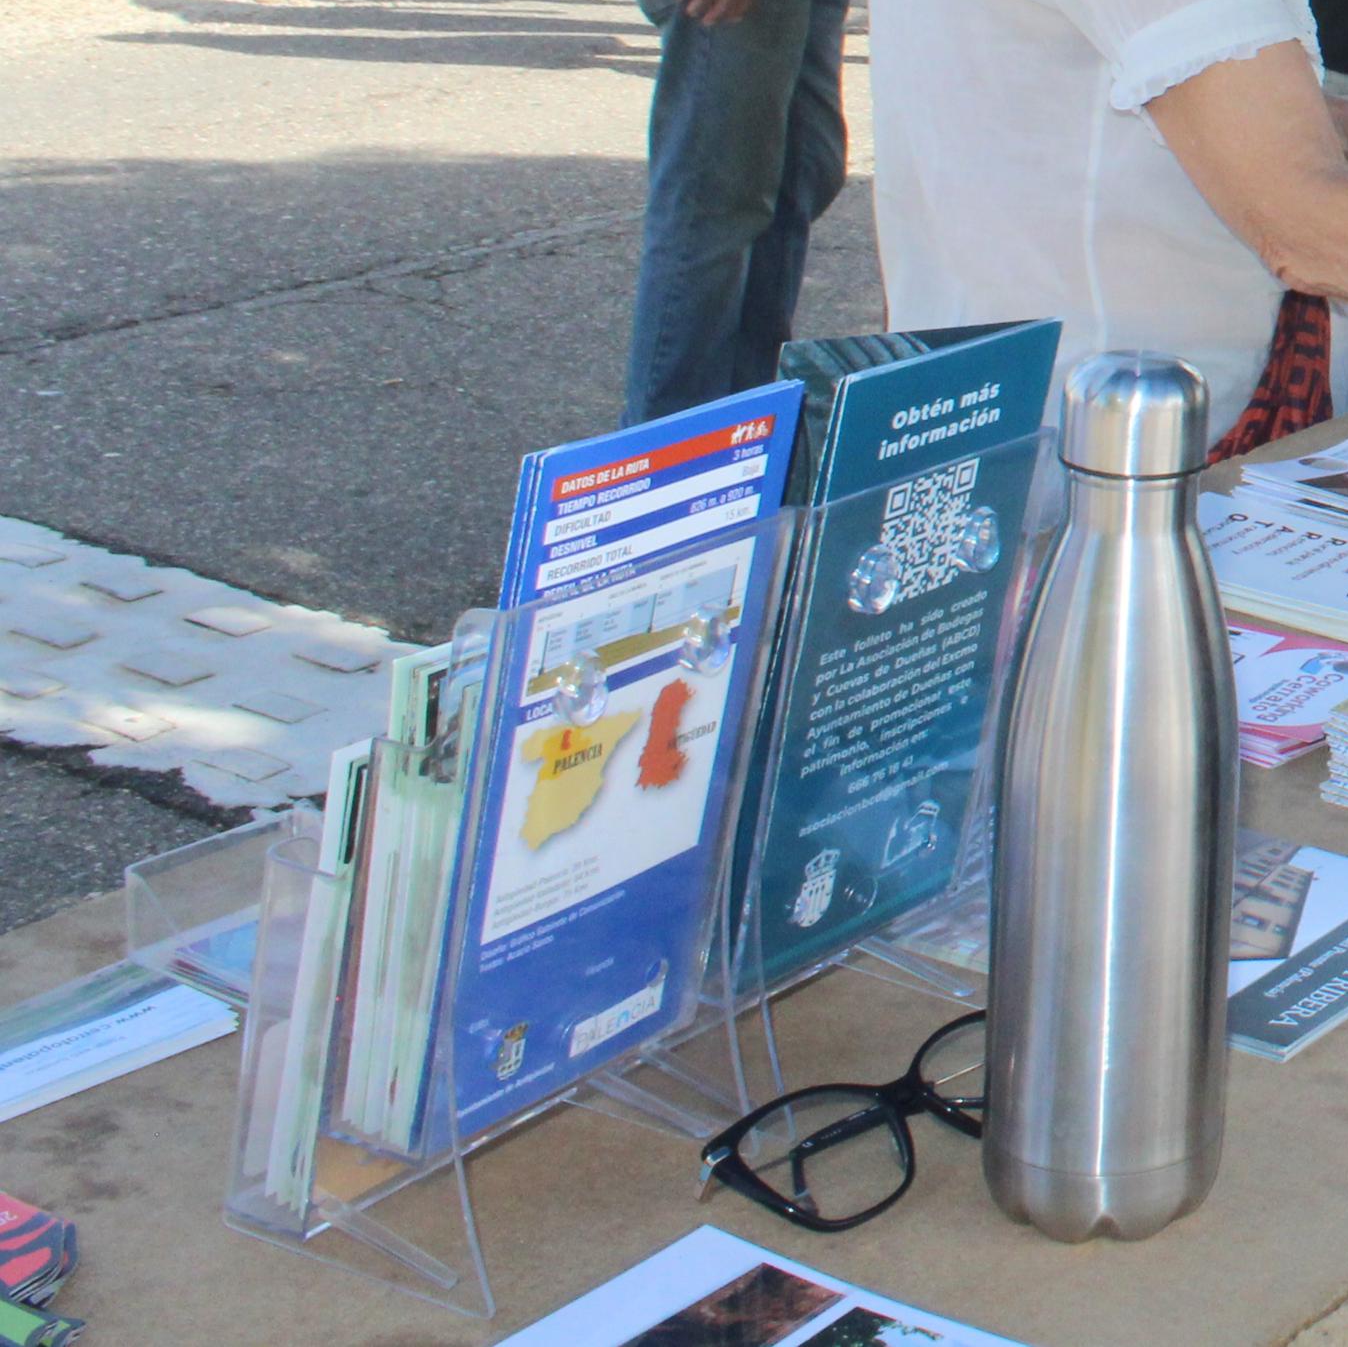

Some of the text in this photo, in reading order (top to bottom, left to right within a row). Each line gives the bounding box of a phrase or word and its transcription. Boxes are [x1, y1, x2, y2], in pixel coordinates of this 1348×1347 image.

[891, 381, 1001, 430] Obtén más
[878, 407, 1001, 460] información
[557, 477, 652, 516] TIEMPO RECORRIDO
[560, 458, 650, 494] DATOS DE LA RUTA
[550, 535, 598, 559] DESNIVEL
[554, 511, 612, 537] DIFICULTAD
[547, 545, 633, 581] RECORRIDO TOTAL
[815, 608, 984, 686] por La Asociación de Bodegas
[820, 590, 988, 666] Este folleto ha sido creado
[812, 623, 981, 706] y Cuevas de Dueñas (ABCD)
[806, 660, 976, 740] Ayuntamiento de Dueñas con
[809, 705, 833, 721] con
[834, 698, 846, 711] la
[847, 666, 922, 706] colaboración
[922, 658, 941, 673] del
[1252, 675, 1317, 712] Cerrato
[1256, 673, 1344, 722] Coworking
[803, 678, 972, 758] el fin de promocionar este
[880, 702, 953, 742] inscripciones
[553, 743, 603, 775] PALENCIA
[0, 1004, 157, 1071] www.cerratopalen
